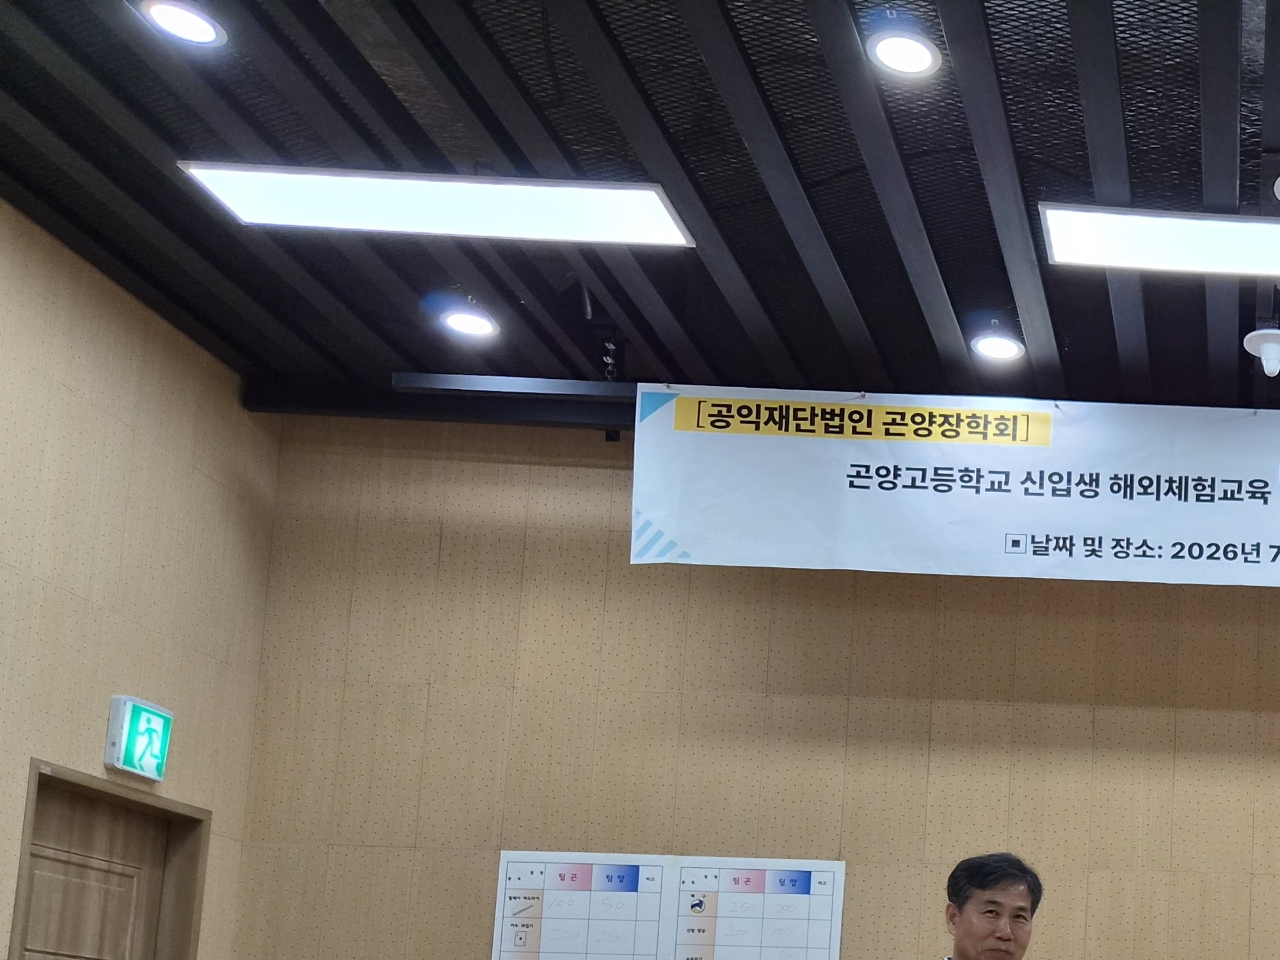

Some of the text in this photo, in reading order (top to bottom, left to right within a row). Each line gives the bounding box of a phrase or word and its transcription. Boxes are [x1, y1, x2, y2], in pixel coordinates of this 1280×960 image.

[696, 400, 1031, 443] [공익재단법인 곤양장학회]
[846, 462, 1012, 495] 곤양고등학교
[1019, 468, 1101, 499] 신입생
[1108, 473, 1272, 505] 해외체험교육
[1030, 533, 1076, 559] 날짜
[1082, 535, 1104, 559] 및
[1110, 536, 1164, 560] 장소:
[1170, 540, 1263, 566] 2026년
